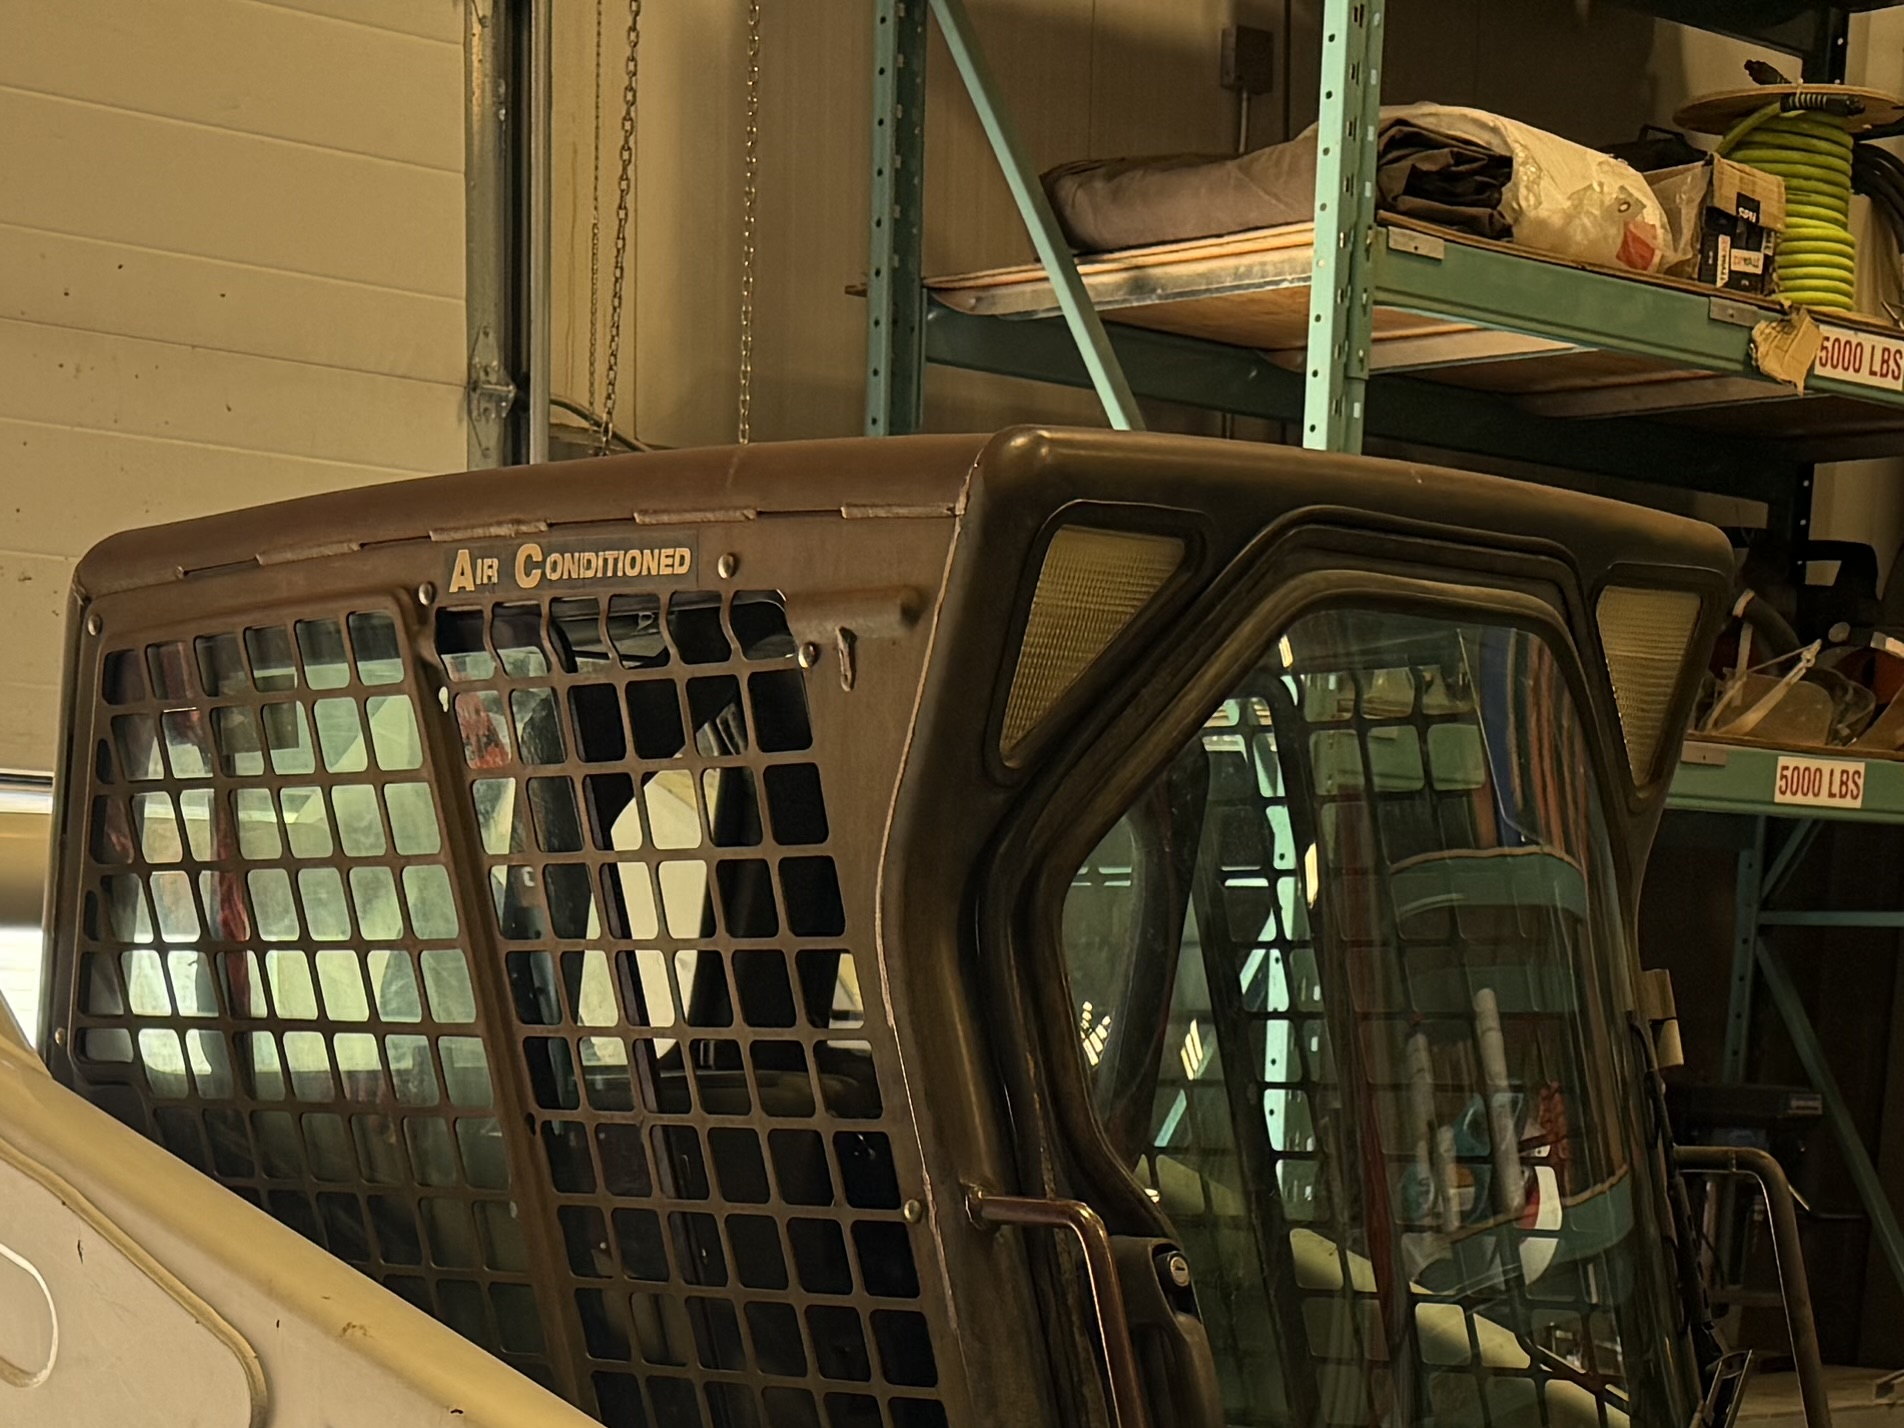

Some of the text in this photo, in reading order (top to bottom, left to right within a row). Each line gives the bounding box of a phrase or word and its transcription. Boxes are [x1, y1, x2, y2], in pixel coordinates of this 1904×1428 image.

[1818, 337, 1904, 382] 5000 LBS
[449, 543, 692, 593] AIR CONDITIONED
[1778, 765, 1862, 801] 5000 LBS
